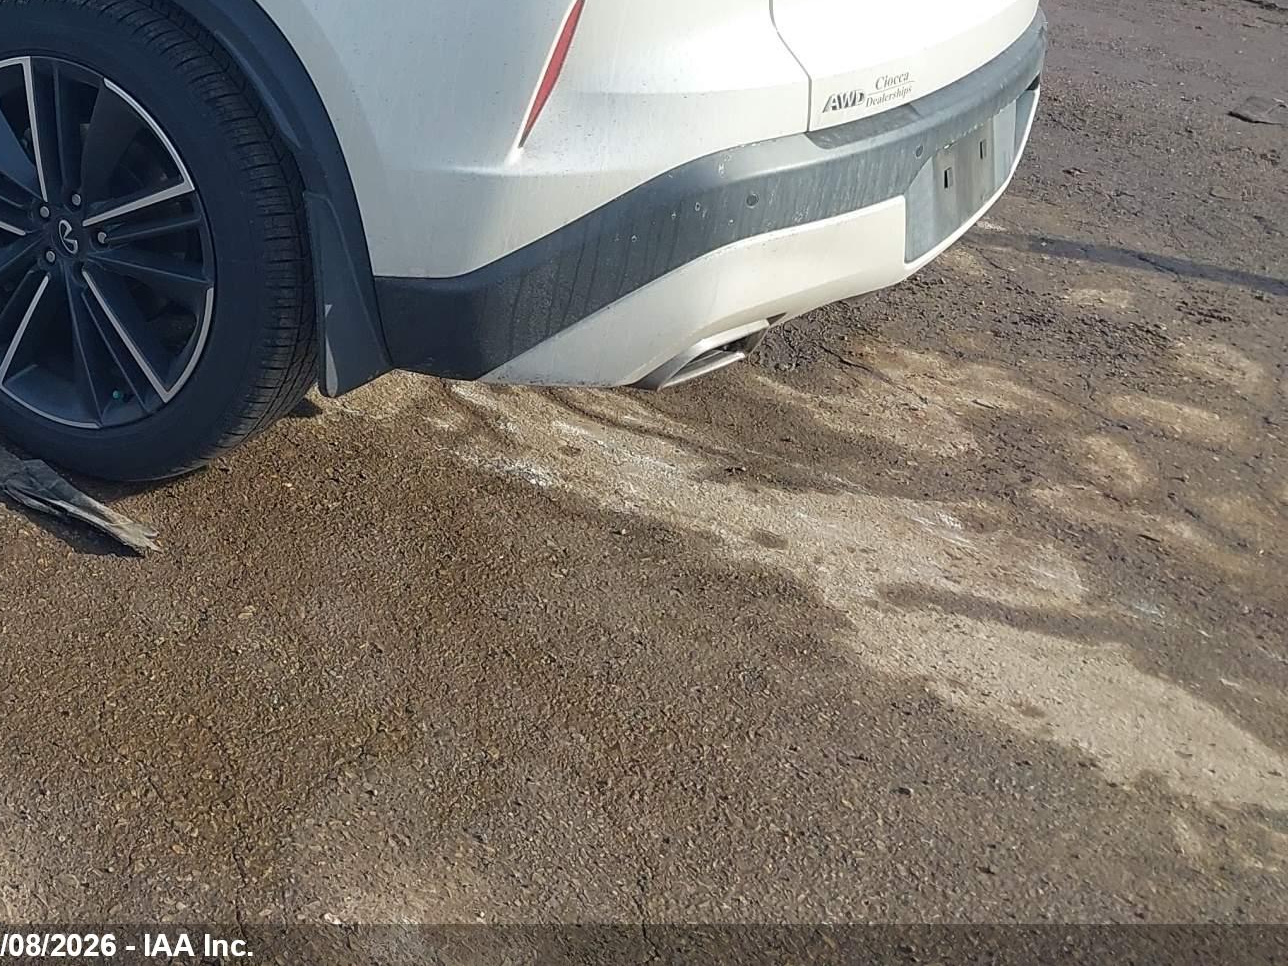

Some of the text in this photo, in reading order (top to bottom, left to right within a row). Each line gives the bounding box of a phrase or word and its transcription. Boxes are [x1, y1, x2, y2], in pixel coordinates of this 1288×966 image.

[875, 71, 910, 91] Ciocca
[822, 89, 866, 113] AWD
[865, 85, 912, 107] Dealerships
